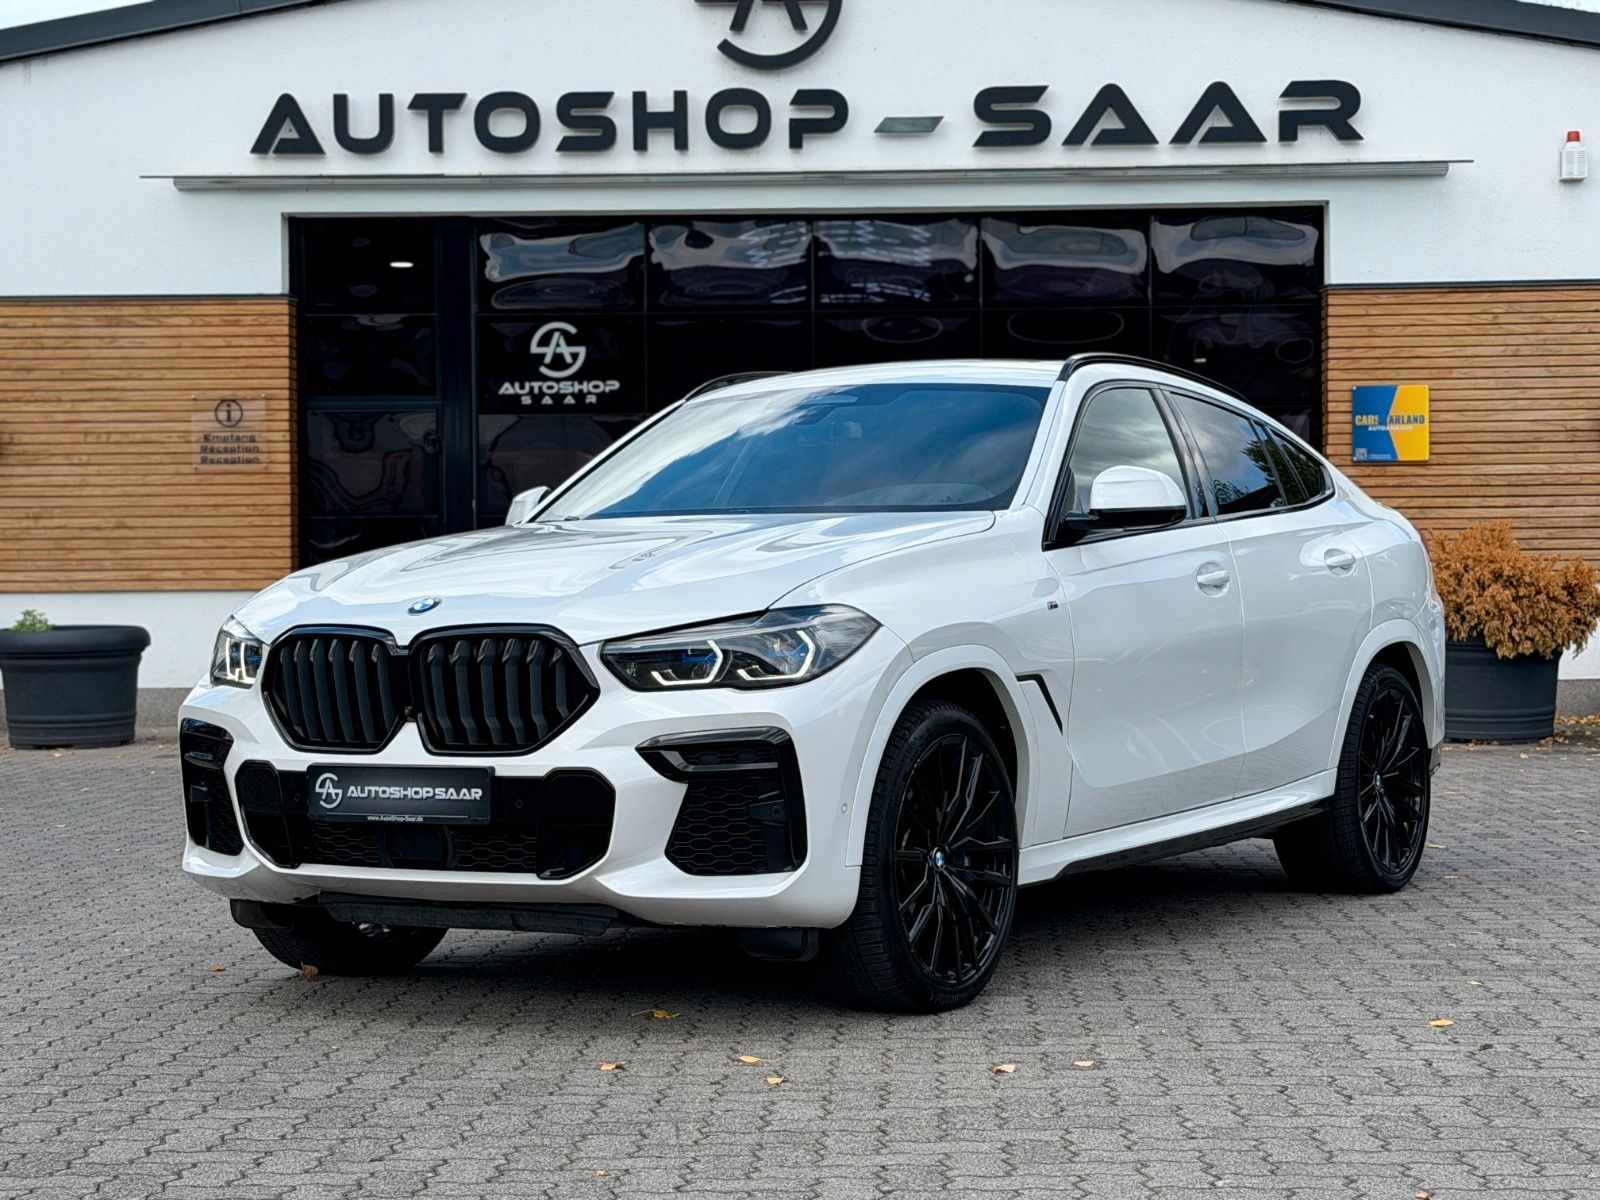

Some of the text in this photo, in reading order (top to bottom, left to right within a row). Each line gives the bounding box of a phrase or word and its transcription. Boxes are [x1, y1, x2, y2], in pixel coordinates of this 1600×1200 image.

[250, 87, 849, 155] AUTOSHOP
[972, 79, 1364, 147] SAAR
[498, 380, 621, 395] AUTOSHOP
[520, 394, 598, 405] SAAR
[203, 434, 256, 442] Empfang
